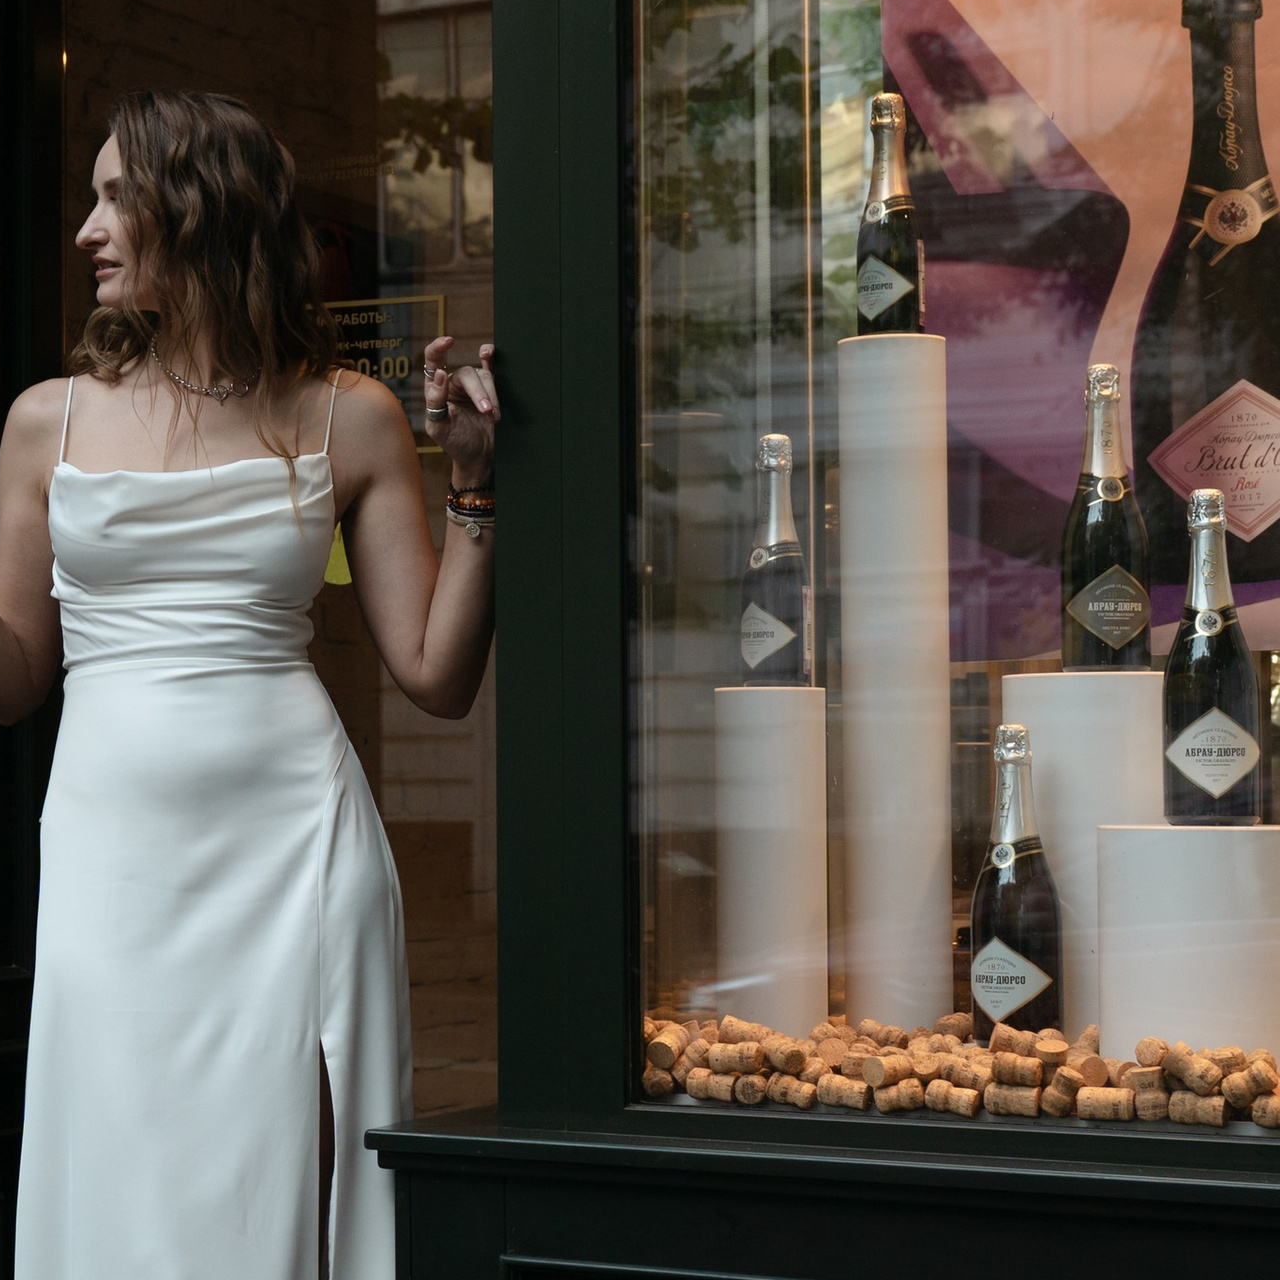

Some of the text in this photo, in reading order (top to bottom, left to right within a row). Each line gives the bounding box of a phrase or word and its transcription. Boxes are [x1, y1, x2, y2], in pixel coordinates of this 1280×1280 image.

[335, 337, 404, 351] ик-четверг
[352, 355, 410, 380] 0:00
[1231, 413, 1258, 423] 1870
[1184, 444, 1253, 473] Brut
[1232, 493, 1261, 502] 2017
[1202, 550, 1217, 587] 1870
